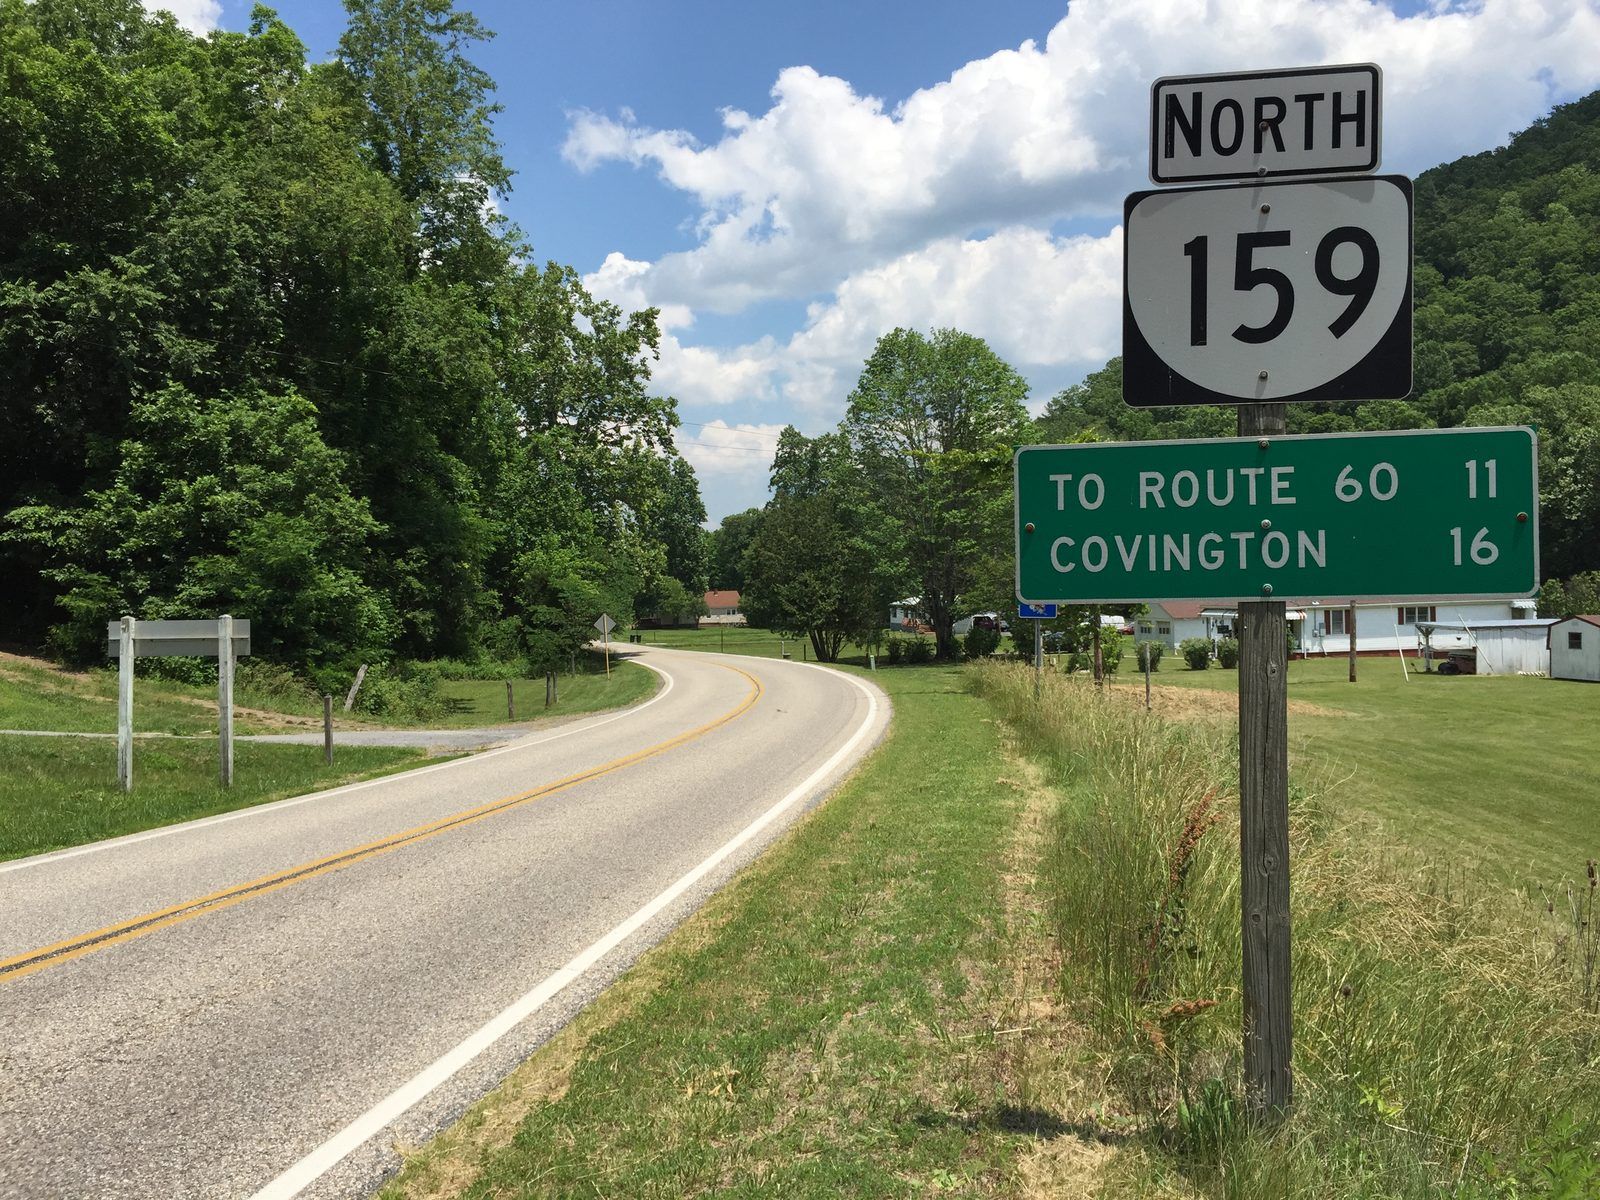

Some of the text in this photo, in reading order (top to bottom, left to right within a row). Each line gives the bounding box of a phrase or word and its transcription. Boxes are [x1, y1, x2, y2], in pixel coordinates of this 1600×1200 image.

[1164, 89, 1367, 159] NORTH
[1183, 225, 1381, 347] 159
[1049, 458, 1497, 511] TO ROUTE 60 11
[1049, 526, 1500, 573] COVINGTON 16
